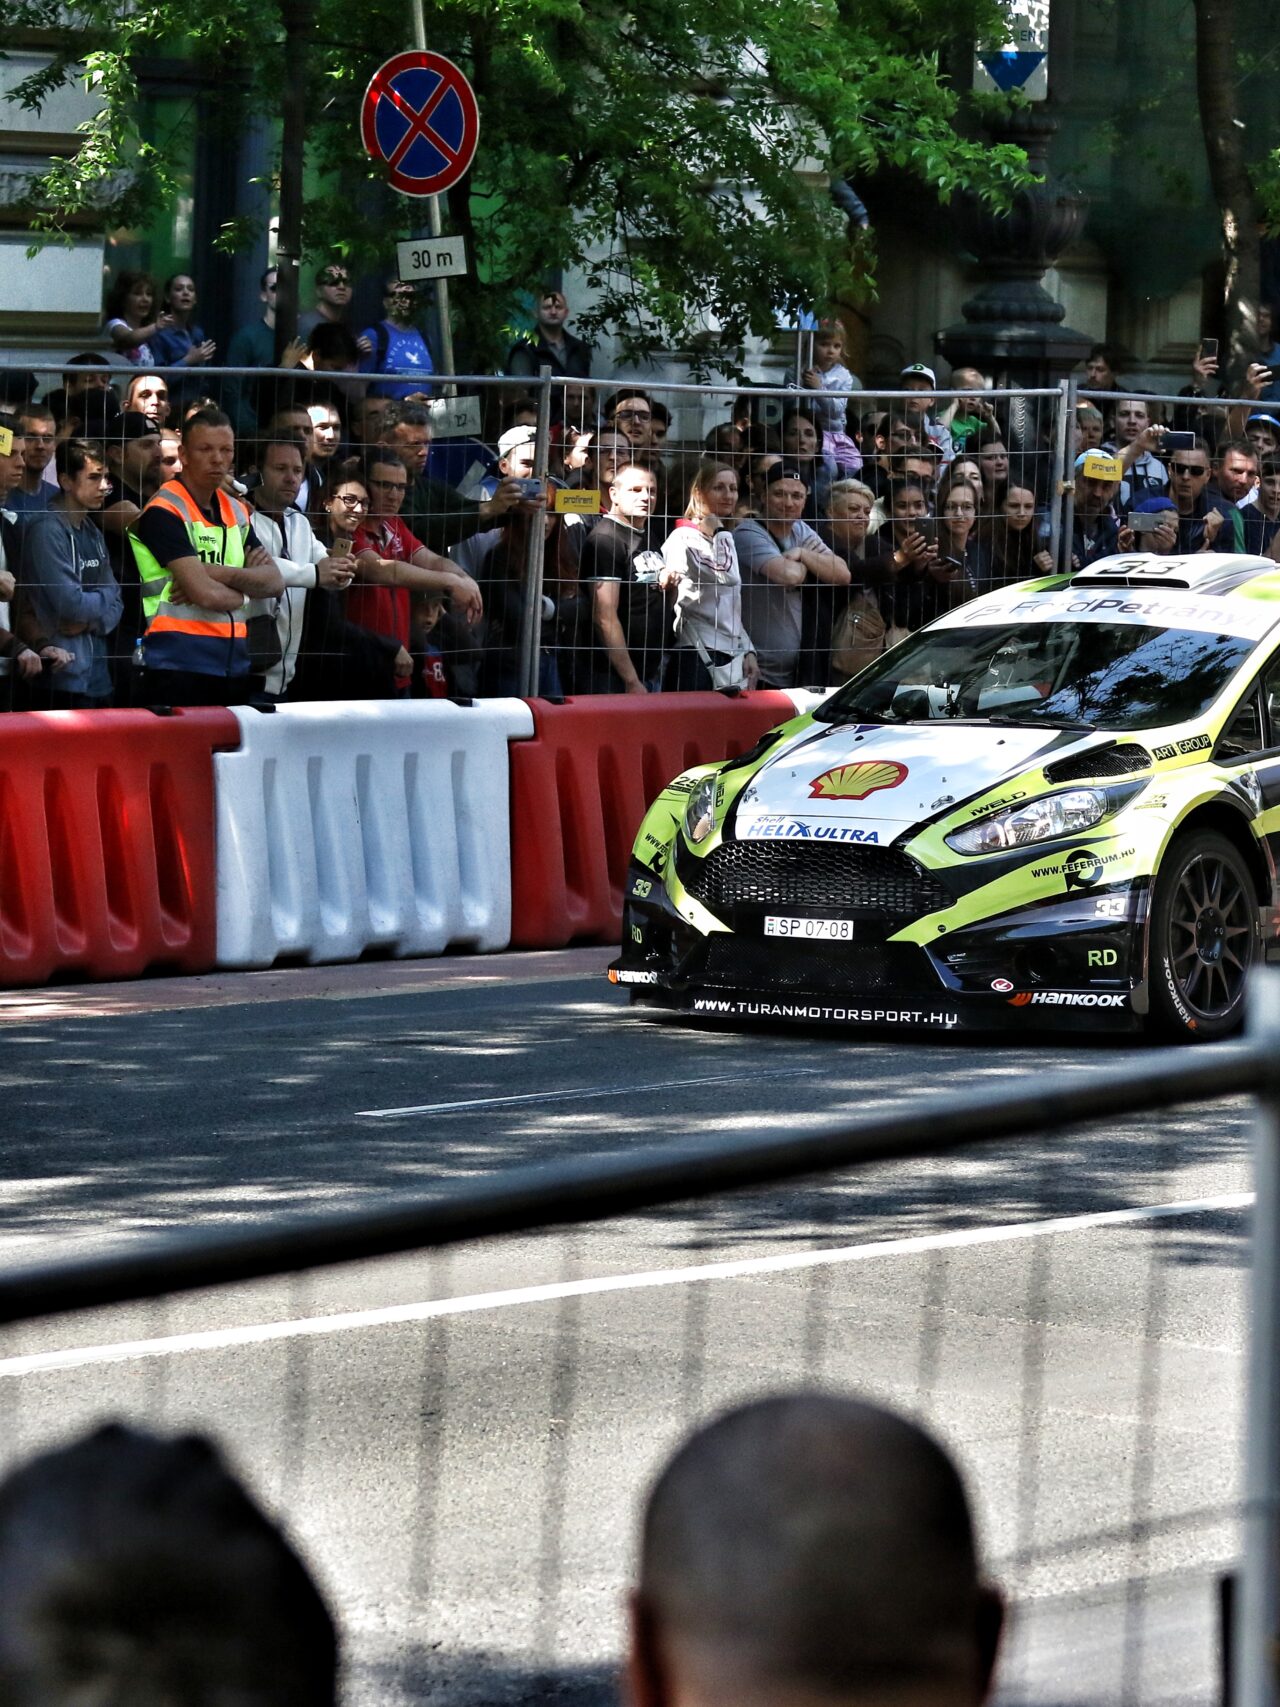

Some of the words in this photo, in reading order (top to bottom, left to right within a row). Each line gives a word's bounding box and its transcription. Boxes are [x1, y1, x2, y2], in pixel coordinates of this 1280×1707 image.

[411, 249, 431, 269] 30
[436, 252, 453, 267] m
[1098, 561, 1187, 575] 33
[1155, 746, 1175, 760] ART
[1178, 735, 1210, 753] GROUP
[746, 820, 812, 837] HELIX
[813, 826, 880, 844] ULTRA
[1031, 847, 1136, 879] WWW.FEFERRUM.HU
[631, 923, 643, 944] RD
[779, 919, 801, 936] SP
[805, 920, 849, 938] 07-08
[1087, 949, 1119, 967] RD
[693, 998, 959, 1025] WWW.TURANMOTORSPORT.HU
